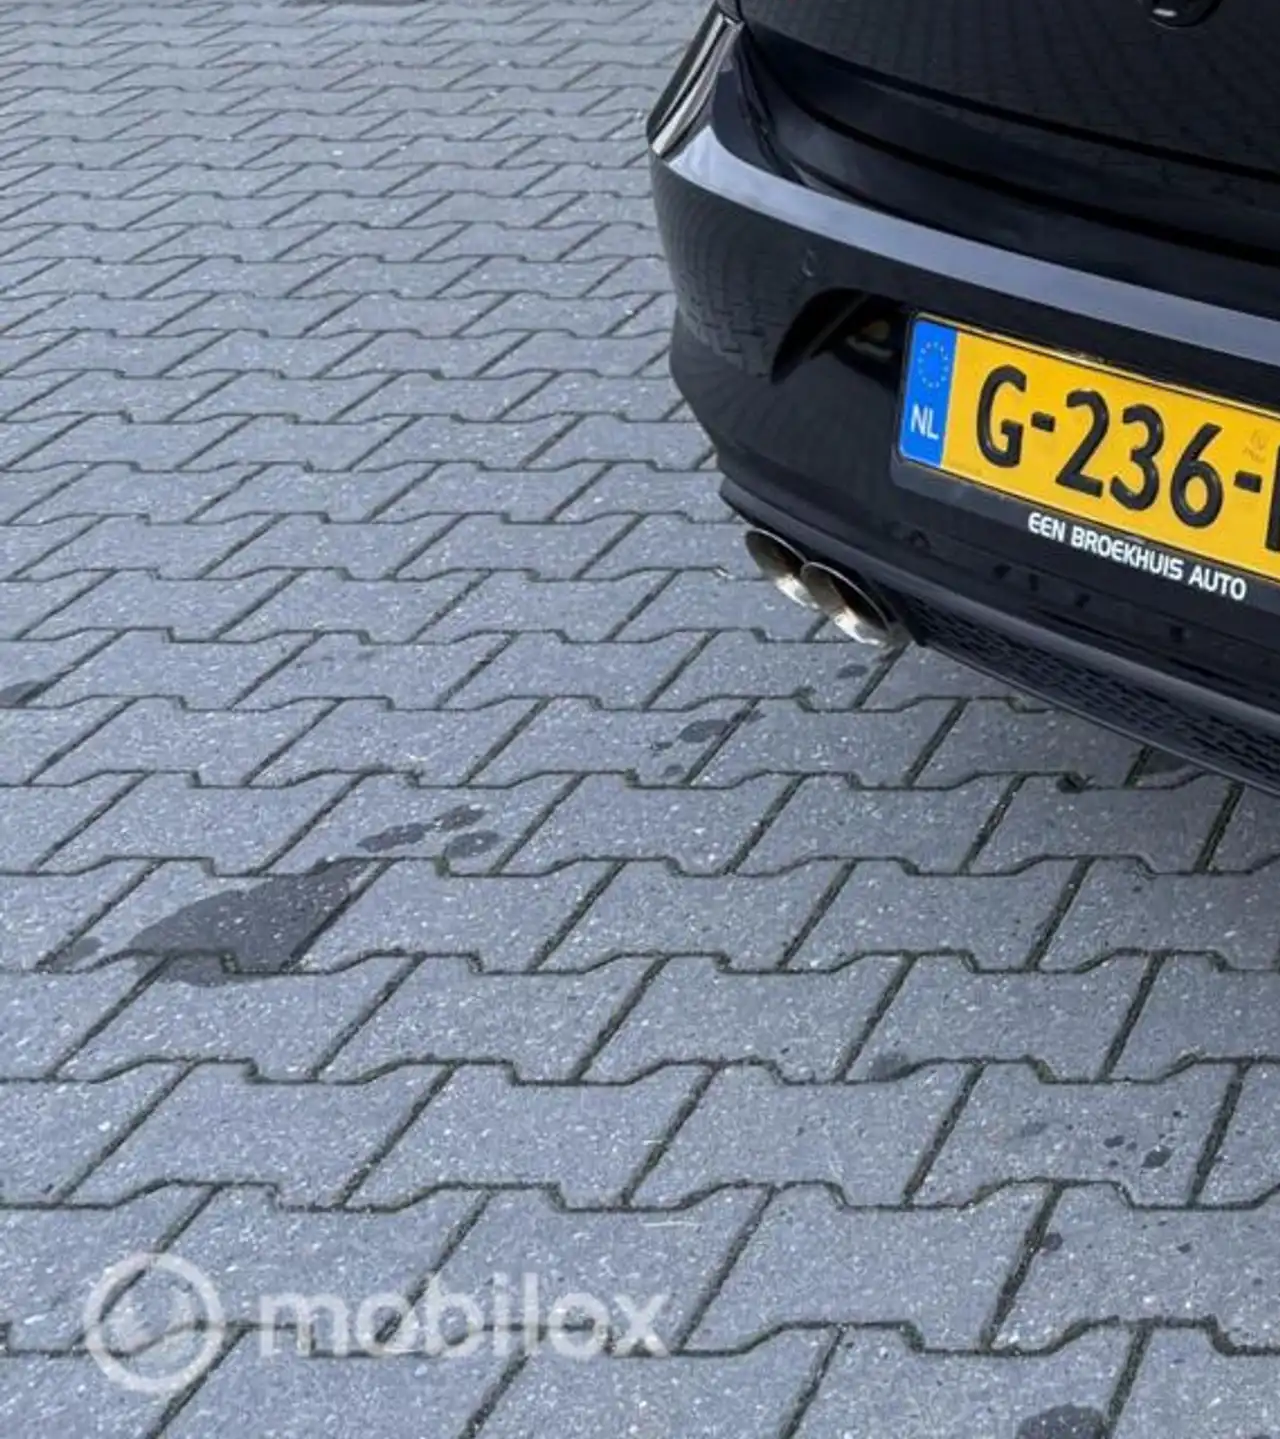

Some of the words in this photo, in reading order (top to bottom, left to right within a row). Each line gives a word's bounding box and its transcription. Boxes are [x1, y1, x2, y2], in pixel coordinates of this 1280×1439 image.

[910, 403, 940, 440] NL
[1028, 512, 1066, 542] EEN
[1070, 526, 1184, 581] BROEKHUIS
[1188, 565, 1247, 601] AUTO
